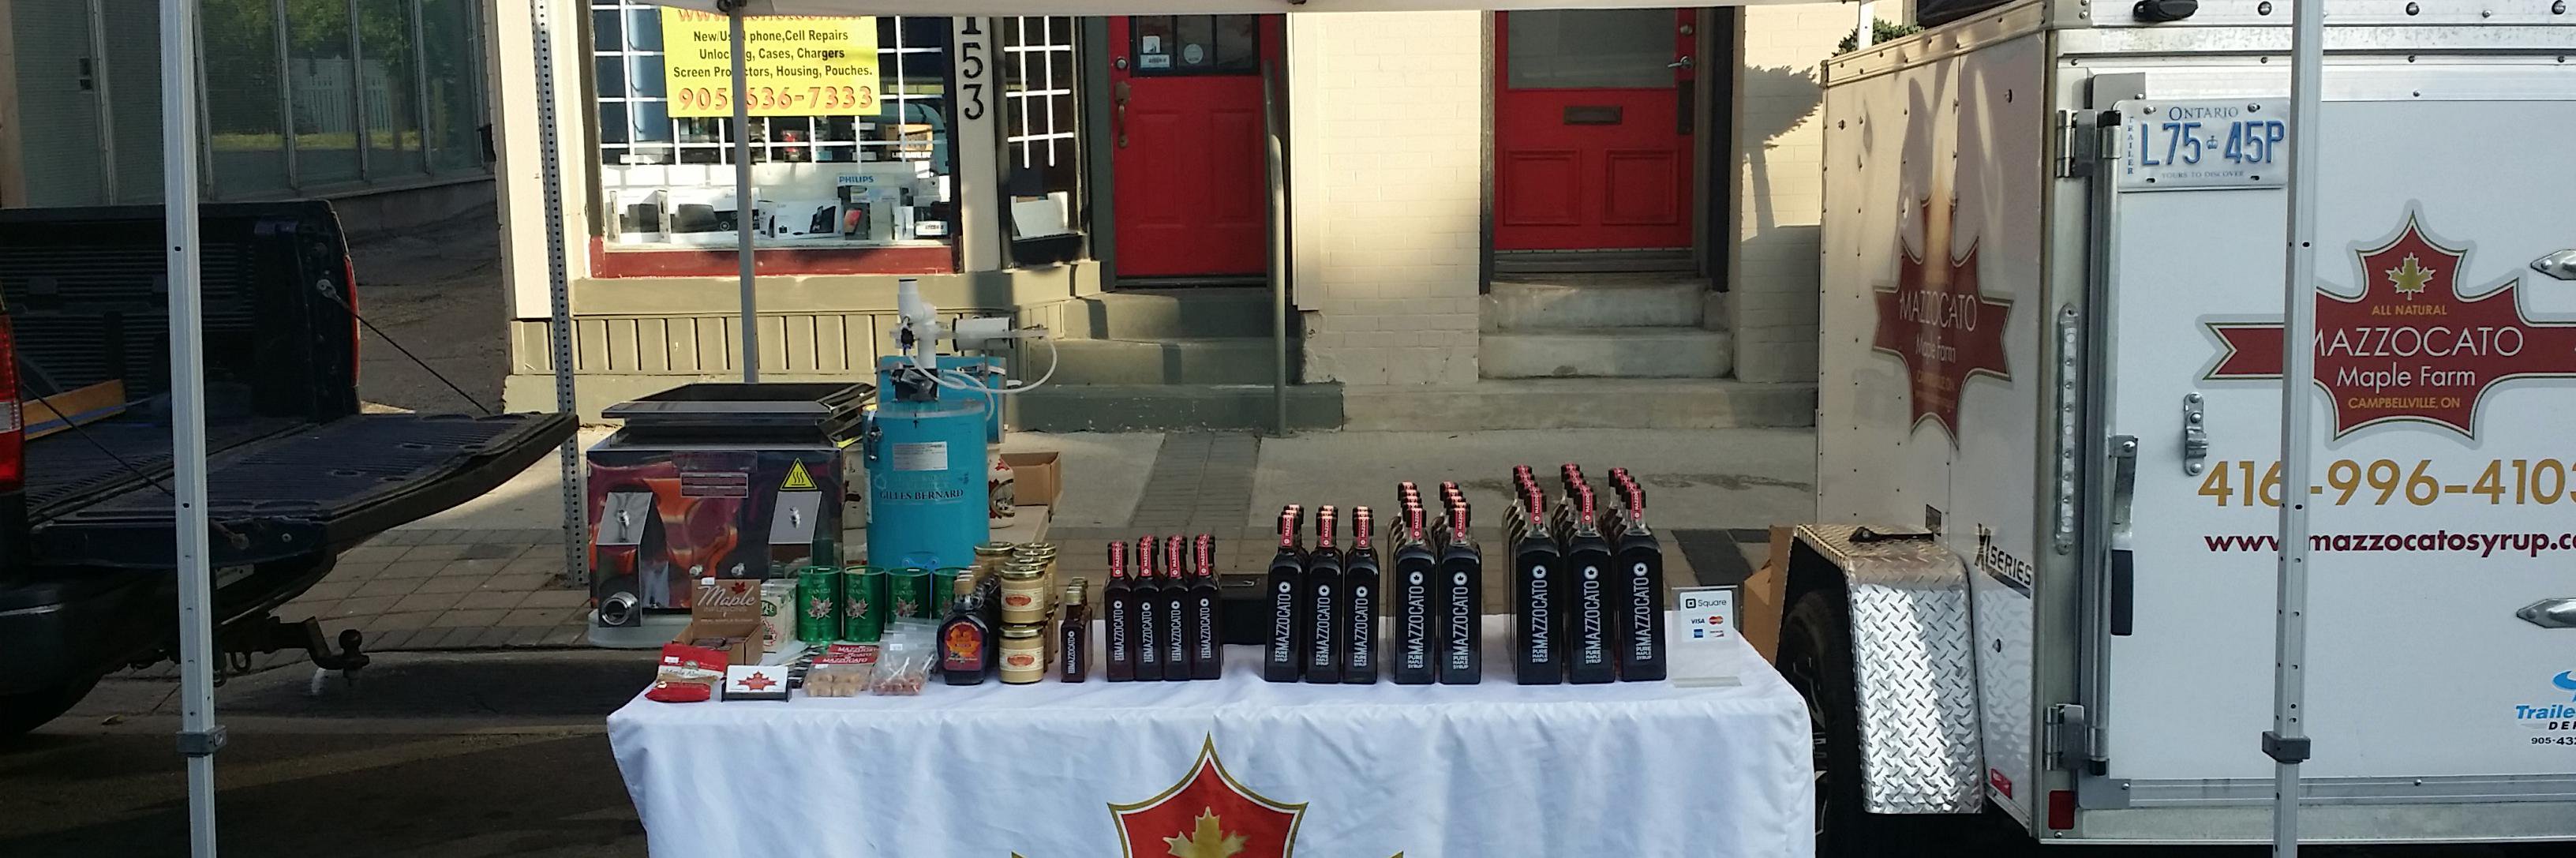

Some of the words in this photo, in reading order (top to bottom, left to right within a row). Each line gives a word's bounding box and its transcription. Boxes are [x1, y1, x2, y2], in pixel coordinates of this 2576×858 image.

[700, 49, 755, 62] Unlocg,
[758, 48, 794, 61] Cases,
[797, 47, 845, 60] Chargers
[809, 30, 848, 43] Repairs
[674, 67, 710, 77] Screen
[714, 66, 773, 79] Proctors,
[777, 66, 822, 79] Housing,
[826, 66, 873, 76] Pouches.
[679, 86, 873, 111] 905636-7333
[2141, 122, 2202, 166] L75
[2224, 120, 2285, 163] 45P
[1899, 290, 1977, 332] MAZZOCATO
[2372, 305, 2391, 316] ALL
[2395, 305, 2447, 316] NATURAL
[2336, 362, 2412, 394] Maple
[2420, 365, 2476, 386] Farm
[2348, 397, 2438, 410] CAMPBELLVILLE,
[2440, 397, 2461, 409] ON
[879, 491, 912, 500] GILLES
[915, 489, 964, 500] BERNARD
[2197, 459, 2576, 507] 416-996-410
[1990, 545, 2032, 586] SERIES
[698, 585, 757, 607] Maple
[1532, 579, 1548, 650] MAZZOCATO
[1583, 581, 1601, 650] MAZZOCATO
[1634, 577, 1651, 647] MAZZOCATO
[1114, 609, 1124, 653] MAZZOCATO
[1141, 611, 1154, 654] MAZZOCATO
[1171, 609, 1182, 654] MAZZOCATO
[1200, 607, 1211, 651] MAZZOCATO
[1275, 594, 1291, 650] MAZZOCATO
[1316, 597, 1331, 654] MAZZOCATO
[1354, 598, 1368, 655] MAZZOCATO
[1408, 586, 1424, 655] MAZZOCATO
[1452, 586, 1468, 655] MAZZOCATO
[2531, 736, 2576, 745] 905-43
